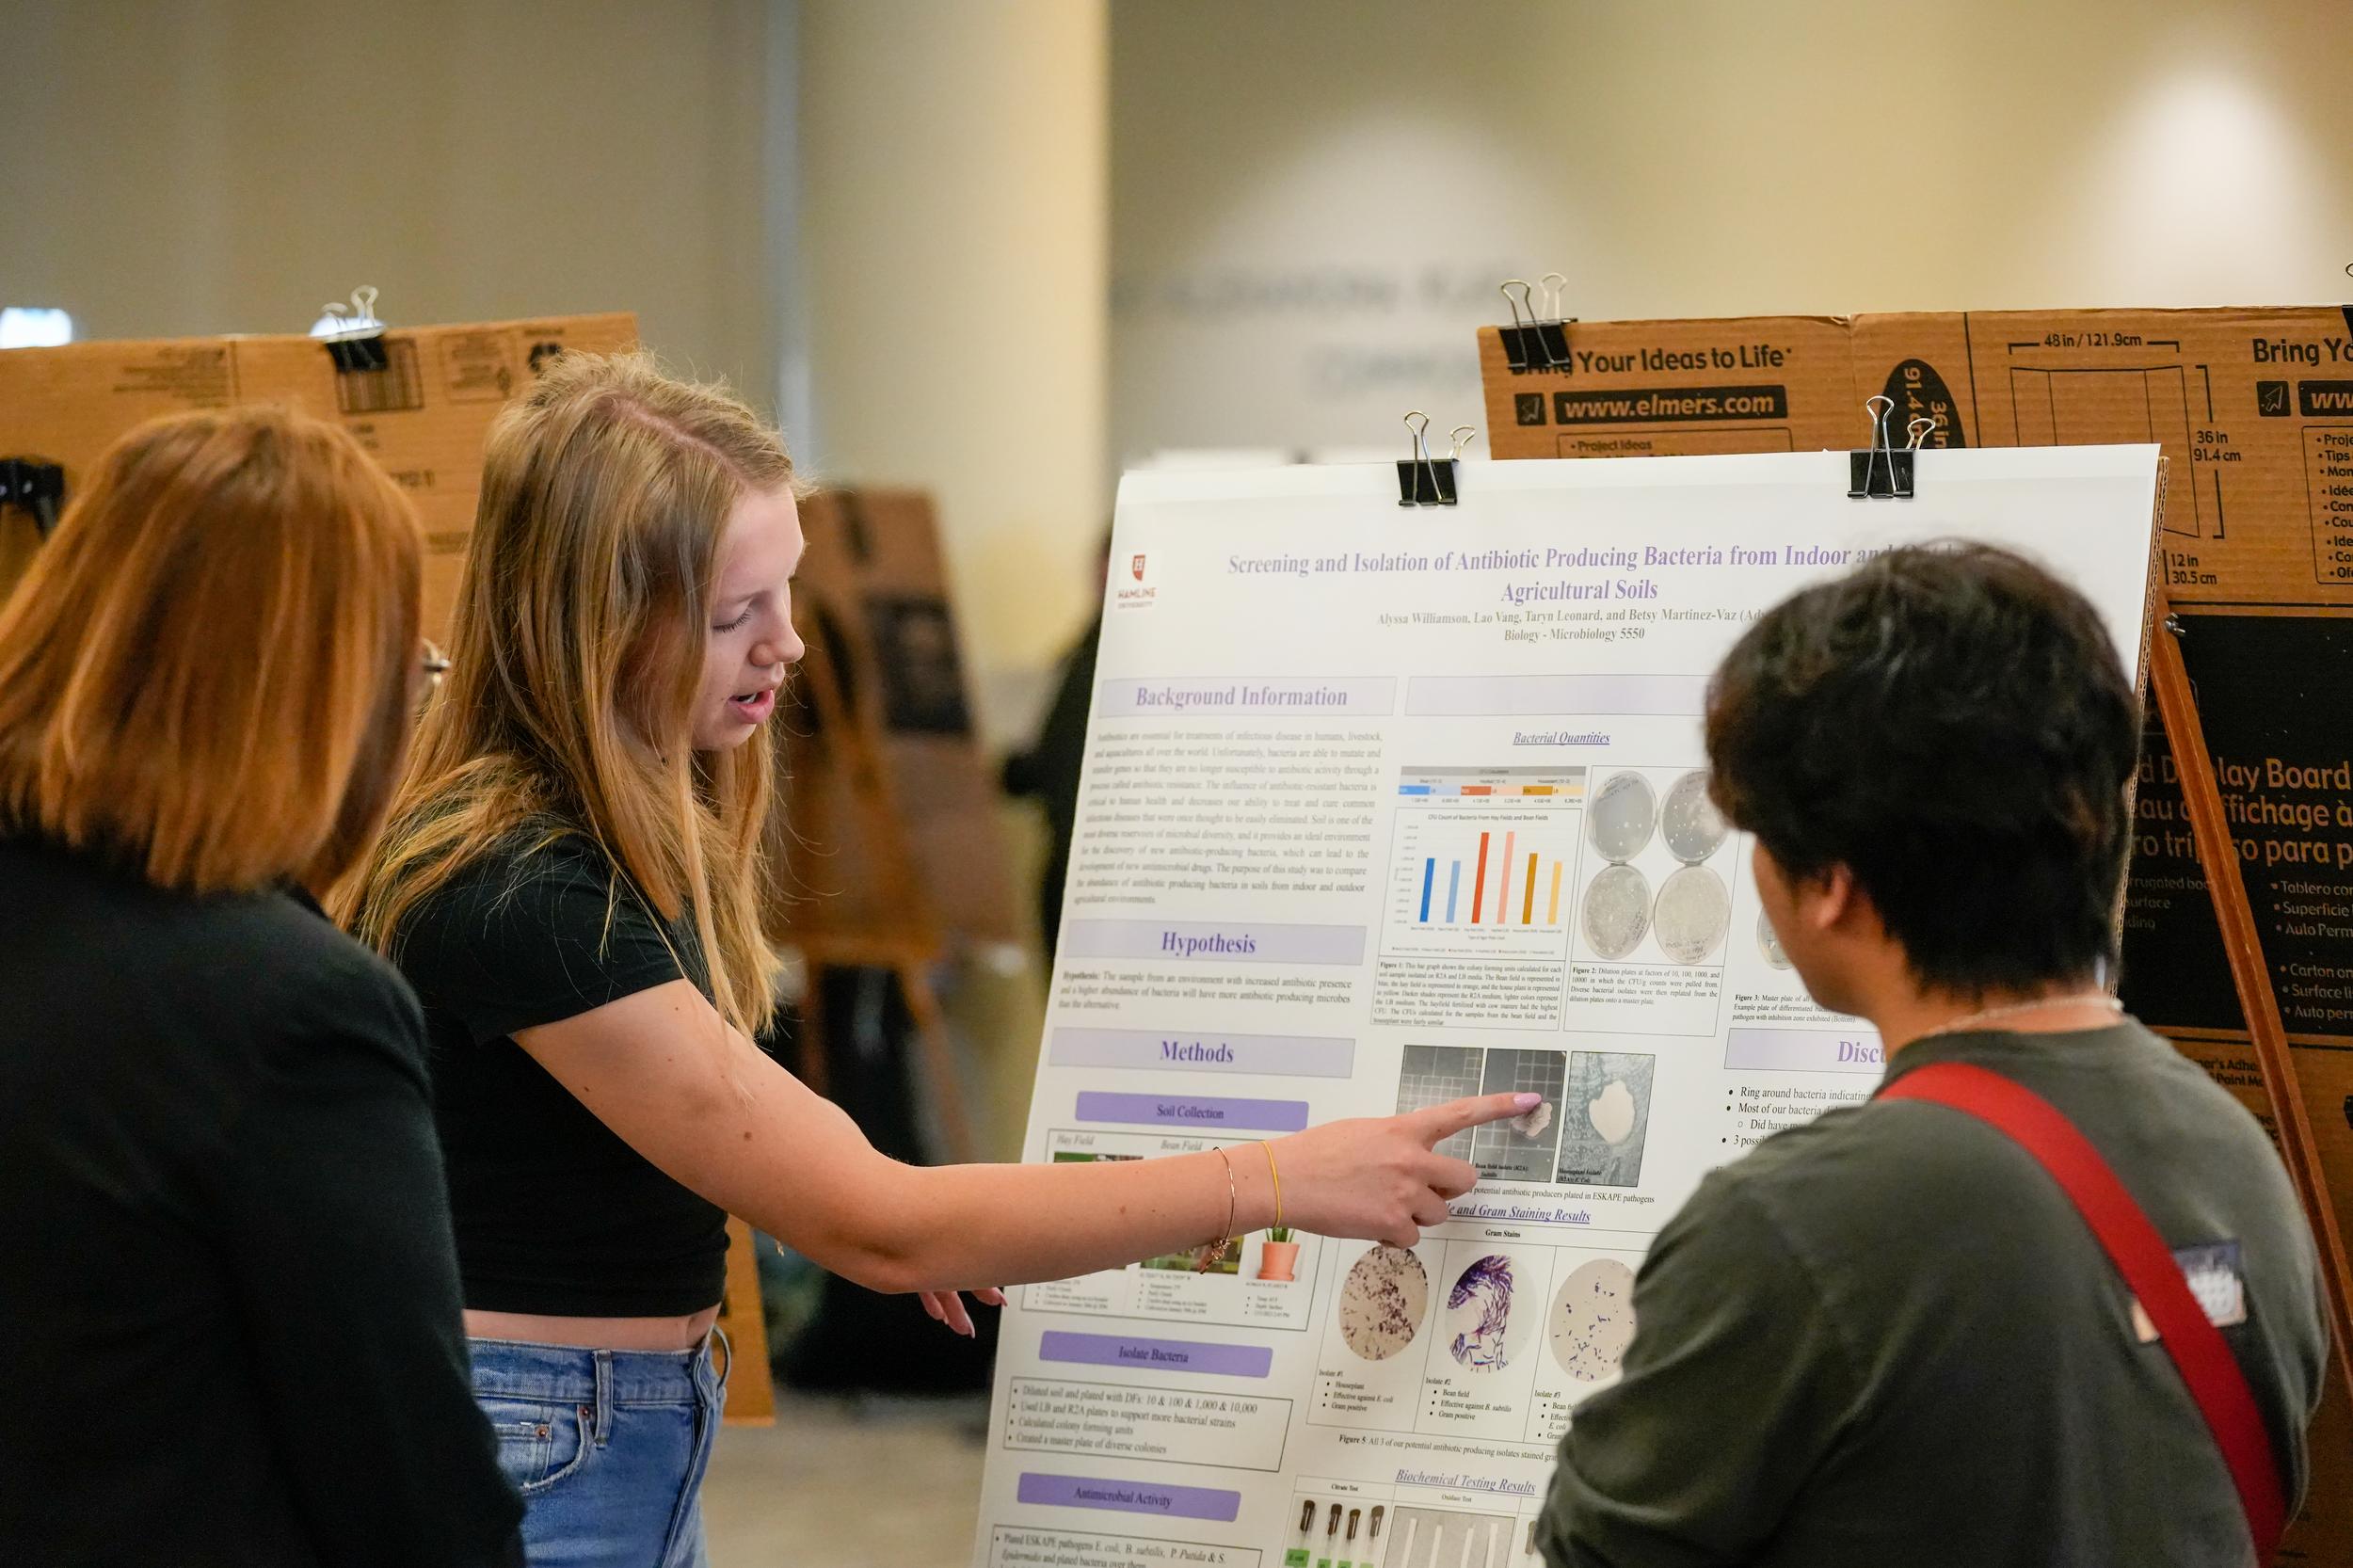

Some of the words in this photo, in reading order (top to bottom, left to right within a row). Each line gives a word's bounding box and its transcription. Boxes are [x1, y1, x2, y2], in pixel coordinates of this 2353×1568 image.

[2044, 335, 2060, 346] 48
[2063, 334, 2074, 346] in
[2087, 333, 2142, 346] 121.9cm
[2253, 339, 2319, 366] Bring
[1577, 351, 1636, 373] Your
[1642, 348, 1706, 370] Ideas
[1713, 348, 1735, 368] to
[1904, 367, 1924, 409] 91.4
[1565, 393, 1773, 419] www.elmers.com
[1930, 401, 1948, 426] 36
[2197, 431, 2213, 443] 36
[2217, 431, 2228, 443] in
[1578, 440, 1616, 452] Project
[1620, 440, 1652, 450] Ideas
[2194, 450, 2220, 461] 91.4
[2223, 451, 2241, 461] cm
[2325, 450, 2350, 462] Tips
[1228, 554, 1309, 577] Screening
[1315, 552, 1347, 572] and
[1354, 552, 1428, 572] Isolation
[1434, 552, 1453, 571] of
[1455, 550, 1539, 570] Antibiotic
[1545, 547, 1638, 571] Producing
[1644, 546, 1722, 566] Bacteria
[1730, 544, 1777, 566] from
[1785, 545, 1851, 565] Indoor
[2170, 554, 2184, 567] 12
[2186, 554, 2199, 567] in
[2173, 572, 2198, 584] 30.5
[2201, 574, 2217, 584] cm
[1500, 580, 1610, 607] Agricultural
[1614, 579, 1658, 600] Soils
[1377, 614, 1409, 627] Alyssa
[1413, 612, 1471, 625] Williamson,
[1474, 612, 1493, 624] Lao
[1496, 611, 1522, 624] Vang,
[1525, 610, 1554, 624] Taryn
[1557, 609, 1603, 622] Leonard,
[1606, 609, 1626, 621] and
[1629, 608, 1657, 622] Betsy
[1661, 608, 1737, 621] Martinez-Vaz
[1504, 628, 1540, 644] Biology
[1549, 627, 1615, 642] Microbiology
[1620, 627, 1645, 640] 5550
[1136, 687, 1235, 710] Background
[1241, 687, 1348, 706] Information
[1513, 731, 1557, 744] Bacterial
[1559, 731, 1610, 745] Quantities
[2266, 758, 2350, 790] Board
[2265, 840, 2330, 867] para
[1337, 884, 1365, 892] outdoor
[2281, 881, 2330, 894] Tablero
[2283, 902, 2349, 916] Superficie
[2285, 923, 2315, 936] Auto
[1162, 932, 1256, 956] Hypothesis
[2290, 964, 2334, 978] Carton
[1282, 977, 1316, 988] antibiotic
[1320, 981, 1352, 990] presence
[1276, 992, 1313, 1003] producing
[1317, 992, 1351, 1003] microbes
[2292, 985, 2341, 999] Surface
[2295, 1006, 2324, 1017] Auto
[1160, 1041, 1234, 1063] Methods
[1741, 1087, 1760, 1099] Ring
[1763, 1088, 1790, 1098] around
[1794, 1089, 1826, 1099] bacteria
[1829, 1091, 1871, 1101] indicating
[1158, 1104, 1175, 1117] Soil
[1177, 1105, 1224, 1119] Collection
[1738, 1103, 1759, 1113] Most
[1762, 1103, 1770, 1114] of
[1772, 1105, 1785, 1114] our
[1788, 1104, 1821, 1115] bacteria
[1751, 1119, 1766, 1129] Did
[1768, 1120, 1788, 1130] have
[1161, 1140, 1179, 1151] Bean
[1181, 1141, 1203, 1152] Field
[1734, 1135, 1738, 1145] 3
[1474, 1187, 1500, 1195] potential
[1502, 1189, 1530, 1197] antibiotic
[1532, 1191, 1562, 1199] producers
[1564, 1192, 1583, 1200] plated
[1593, 1192, 1621, 1201] ESKAPE
[1624, 1195, 1655, 1204] pathogens
[1457, 1203, 1477, 1217] and
[1479, 1205, 1506, 1217] Gram
[1509, 1208, 1552, 1222] Staining
[1554, 1209, 1591, 1223] Results
[1118, 1346, 1149, 1359] Isolate
[1151, 1348, 1189, 1363] Bacteria
[1441, 1400, 1464, 1408] Effective
[1339, 1434, 1360, 1445] Figure
[1369, 1437, 1379, 1446] All
[1380, 1438, 1384, 1447] 3
[1385, 1438, 1392, 1447] of
[1405, 1440, 1432, 1450] potential
[1433, 1443, 1462, 1453] antibiotic
[1464, 1445, 1495, 1456] producing
[1497, 1448, 1519, 1458] isolates
[1522, 1450, 1544, 1461] stained
[1396, 1469, 1459, 1485] Biochemical
[1461, 1475, 1496, 1491] Testing
[1499, 1479, 1536, 1493] Results
[1074, 1487, 1134, 1504] Antimicrobial
[1136, 1493, 1173, 1509] Activity
